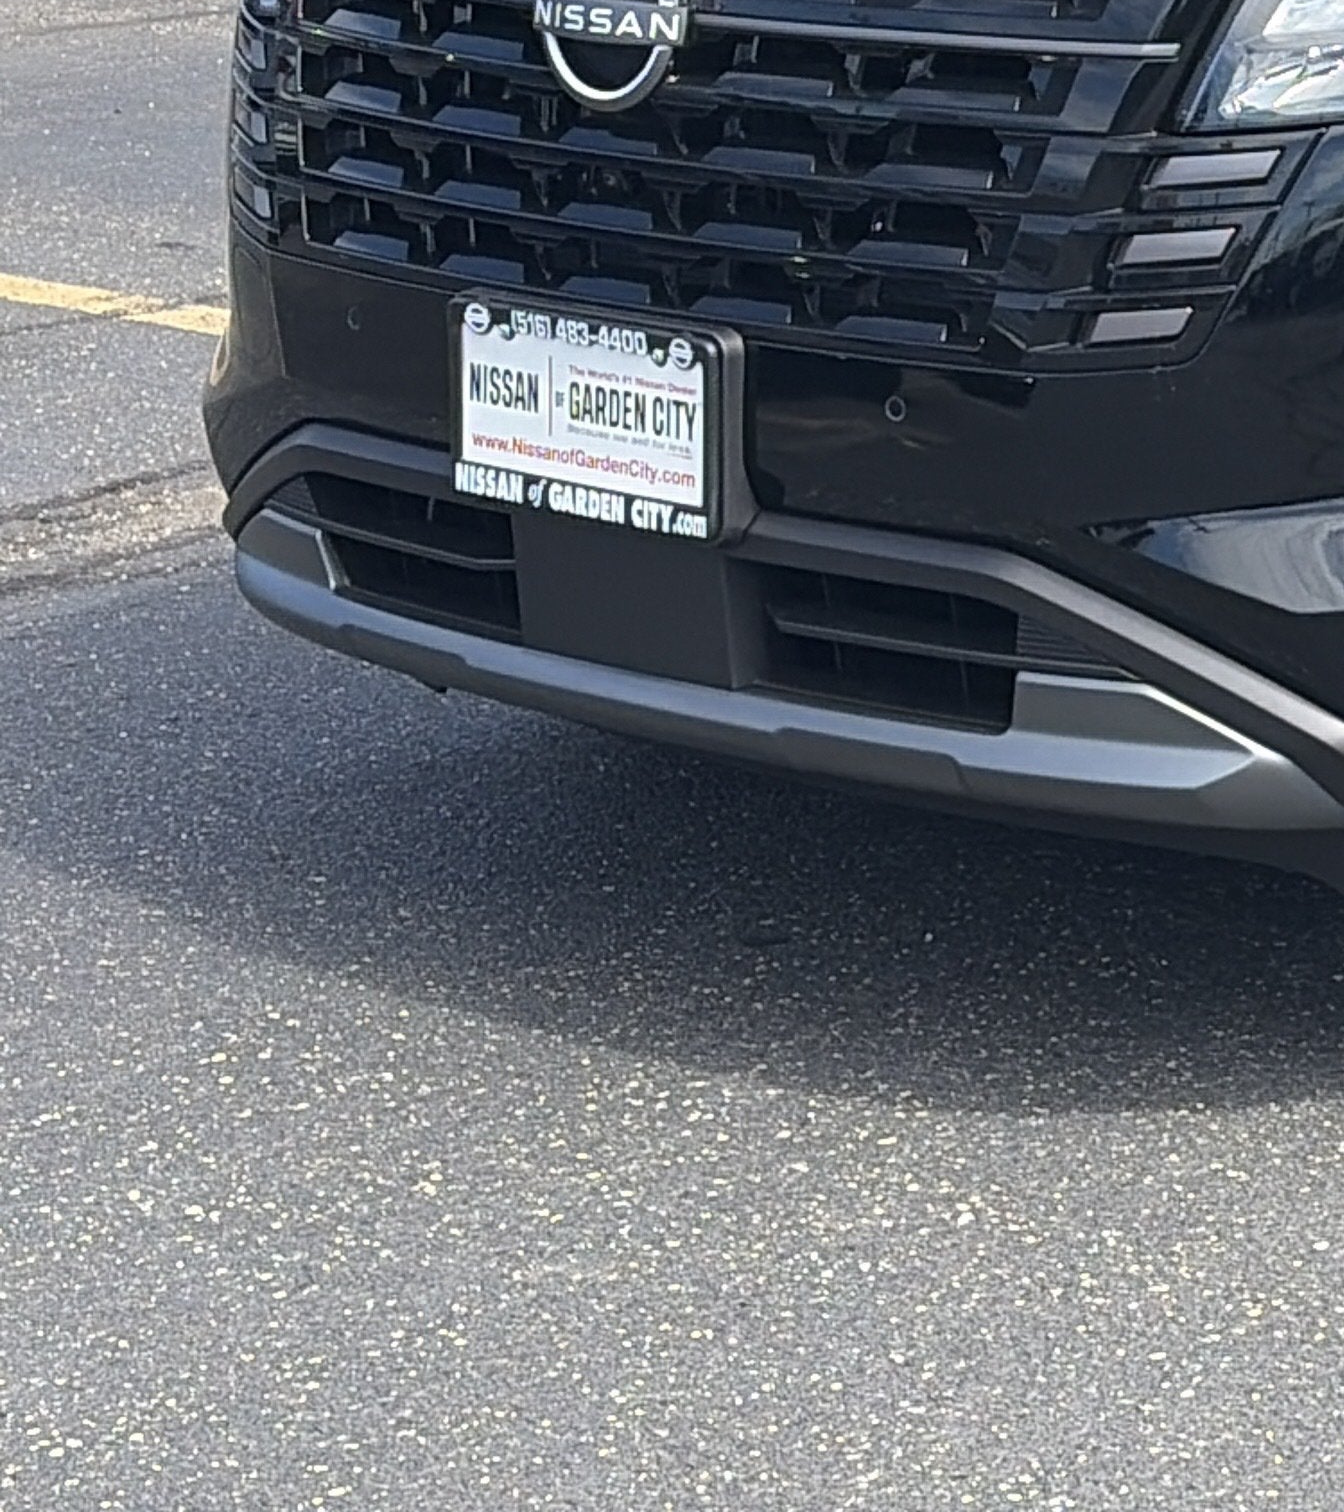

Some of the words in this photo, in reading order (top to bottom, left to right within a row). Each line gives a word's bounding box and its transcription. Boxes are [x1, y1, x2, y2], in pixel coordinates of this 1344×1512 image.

[510, 310, 551, 339] (516)
[555, 318, 649, 356] 483-4400
[469, 362, 539, 413] NISSAN
[569, 381, 647, 434] GARDEN
[653, 396, 698, 442] CITY
[472, 433, 696, 489] www.NissanofGardenCity.com
[455, 461, 524, 504] NISSAN
[527, 478, 548, 508] of
[548, 482, 626, 524] GARDEN
[630, 498, 708, 539] CITY.com
